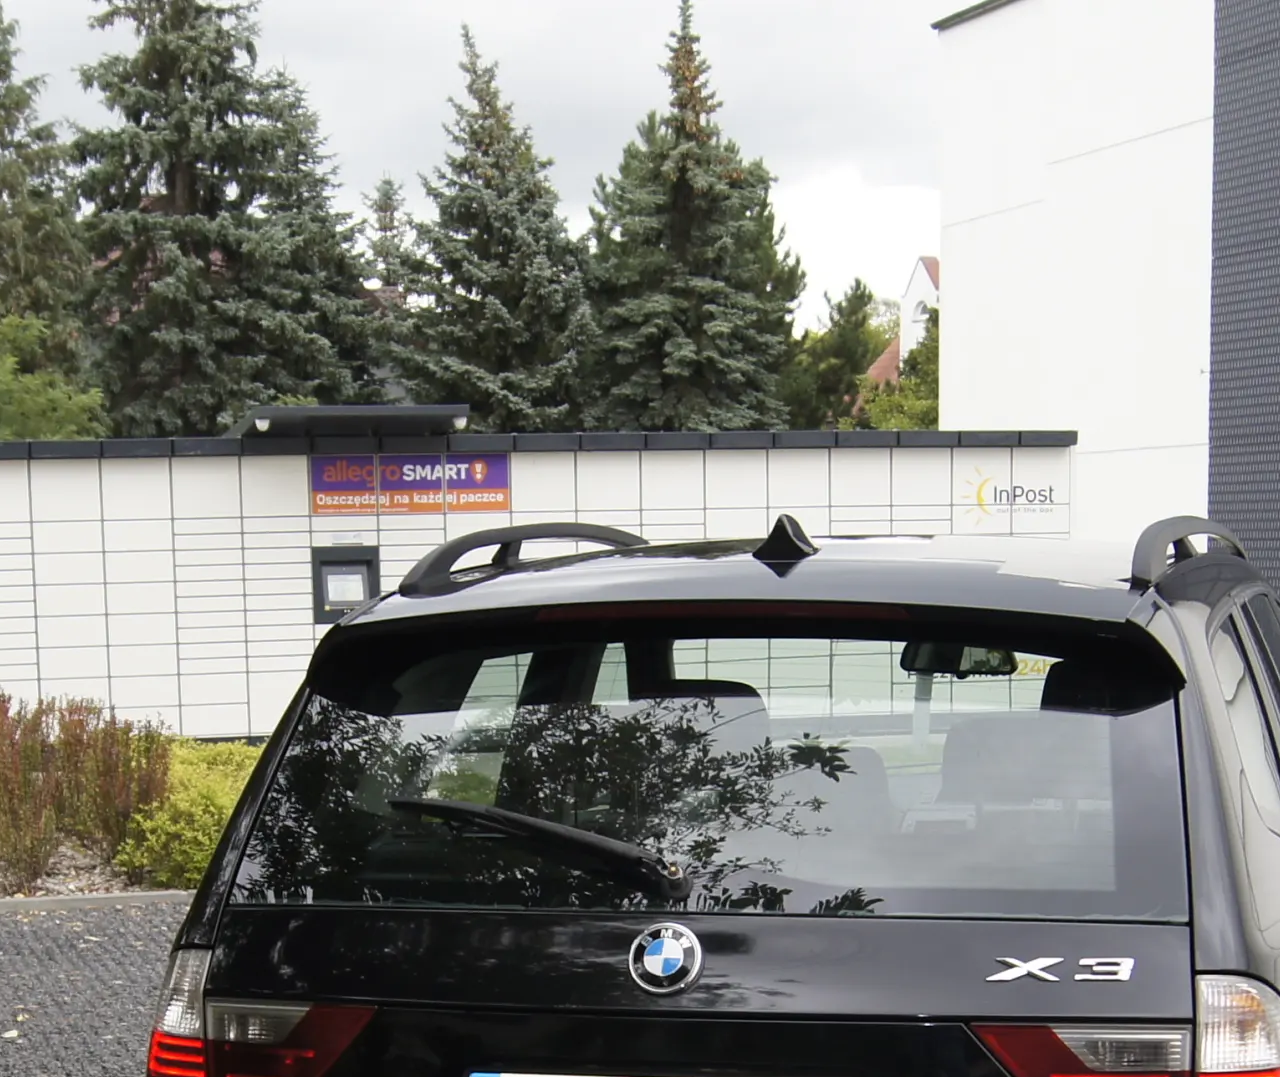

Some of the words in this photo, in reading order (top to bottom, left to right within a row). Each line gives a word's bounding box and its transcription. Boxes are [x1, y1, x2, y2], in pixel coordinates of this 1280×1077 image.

[394, 495, 409, 504] na
[413, 492, 457, 506] każdej
[459, 493, 504, 506] paczce
[993, 485, 1055, 503] InPost
[985, 957, 1135, 981] X3
